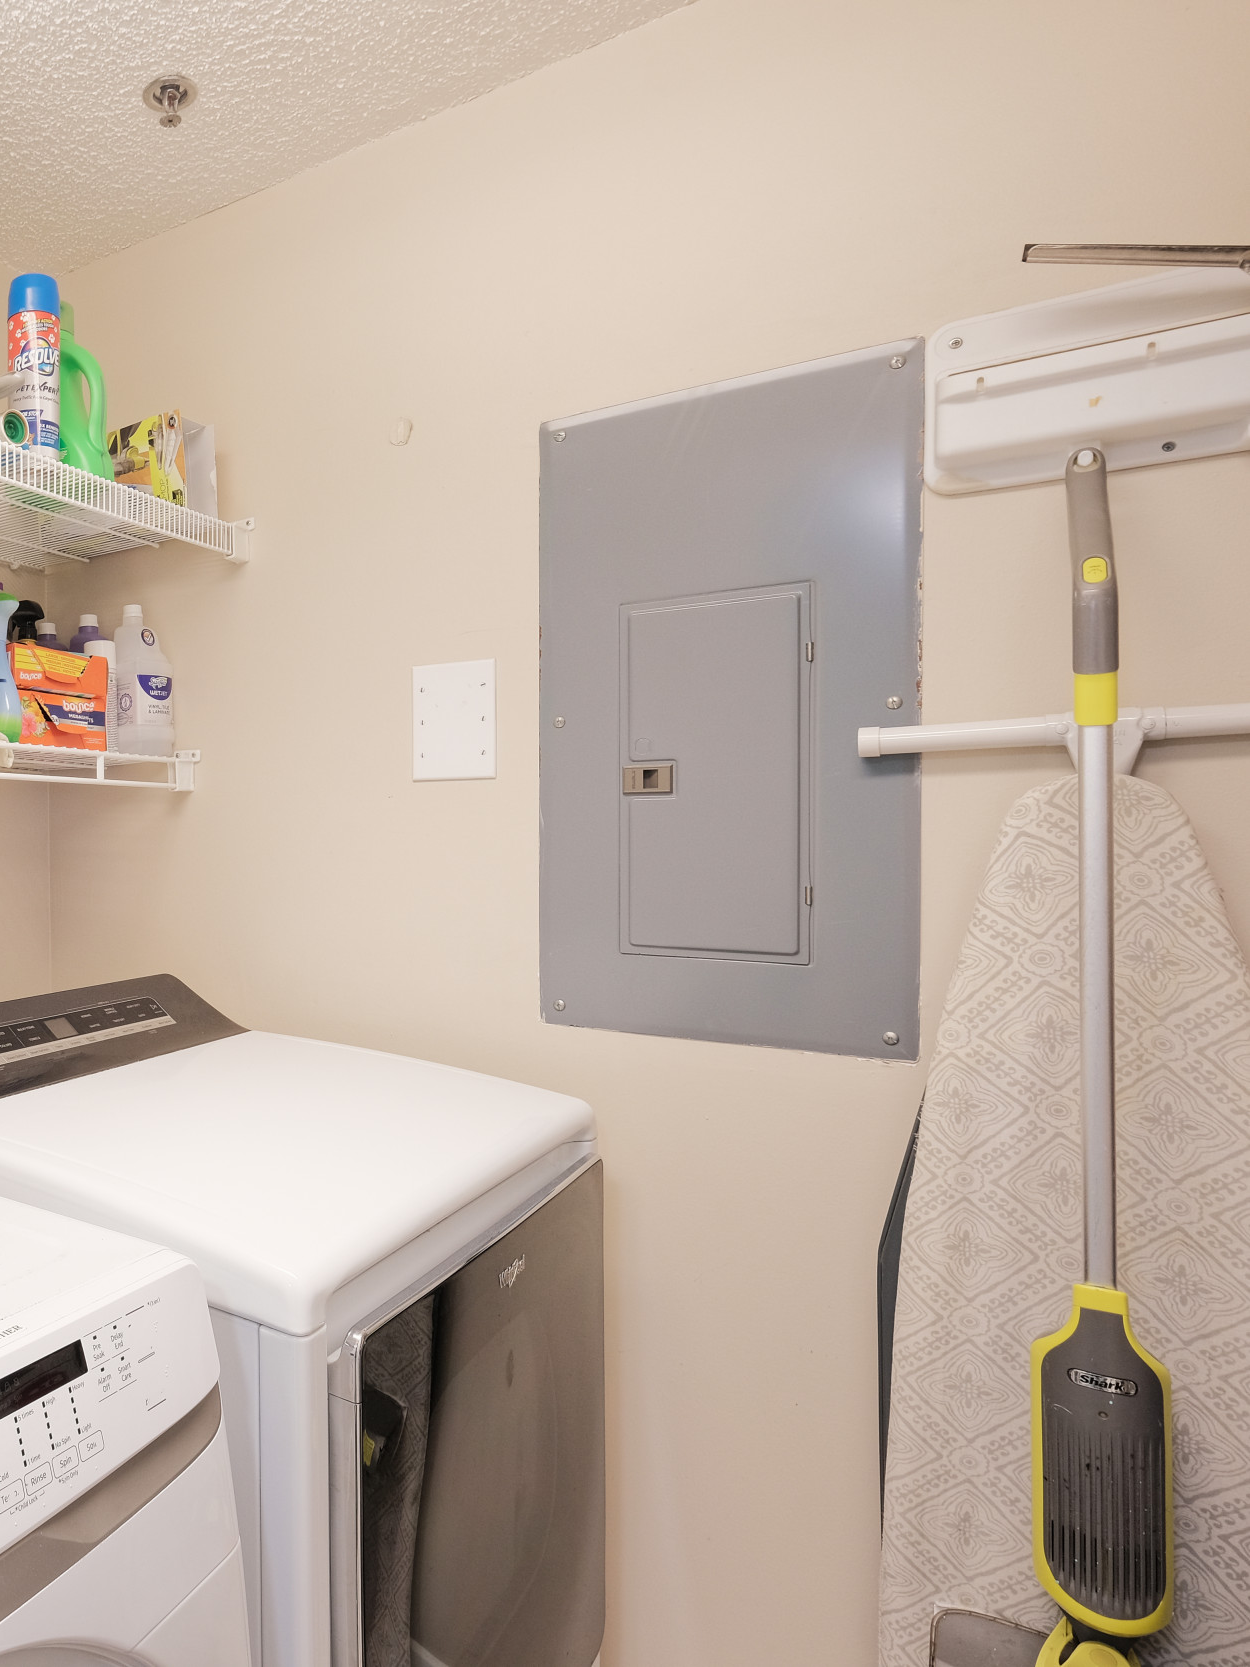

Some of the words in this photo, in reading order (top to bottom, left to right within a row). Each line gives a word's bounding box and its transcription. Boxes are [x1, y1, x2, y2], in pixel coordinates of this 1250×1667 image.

[14, 348, 59, 372] RESOLVE
[20, 671, 42, 681] bounce
[63, 700, 94, 714] bounce
[110, 1332, 123, 1342] Delay
[92, 1343, 101, 1351] Pre
[114, 1340, 124, 1350] End
[93, 1351, 105, 1362] Soak
[117, 1362, 131, 1374] Smart
[97, 1374, 111, 1386] Alarm
[121, 1372, 132, 1381] Care
[71, 1381, 85, 1392] Heavy
[102, 1383, 111, 1392] Off
[1080, 1374, 1125, 1392] Shark
[45, 1396, 56, 1405] High
[21, 1408, 34, 1420] times
[81, 1423, 92, 1433] Light
[62, 1435, 71, 1445] Spin
[30, 1453, 41, 1463] time
[59, 1455, 72, 1468] Spin
[30, 1471, 47, 1487] Rinse
[70, 1469, 79, 1479] Only
[28, 1495, 38, 1505] Lock
